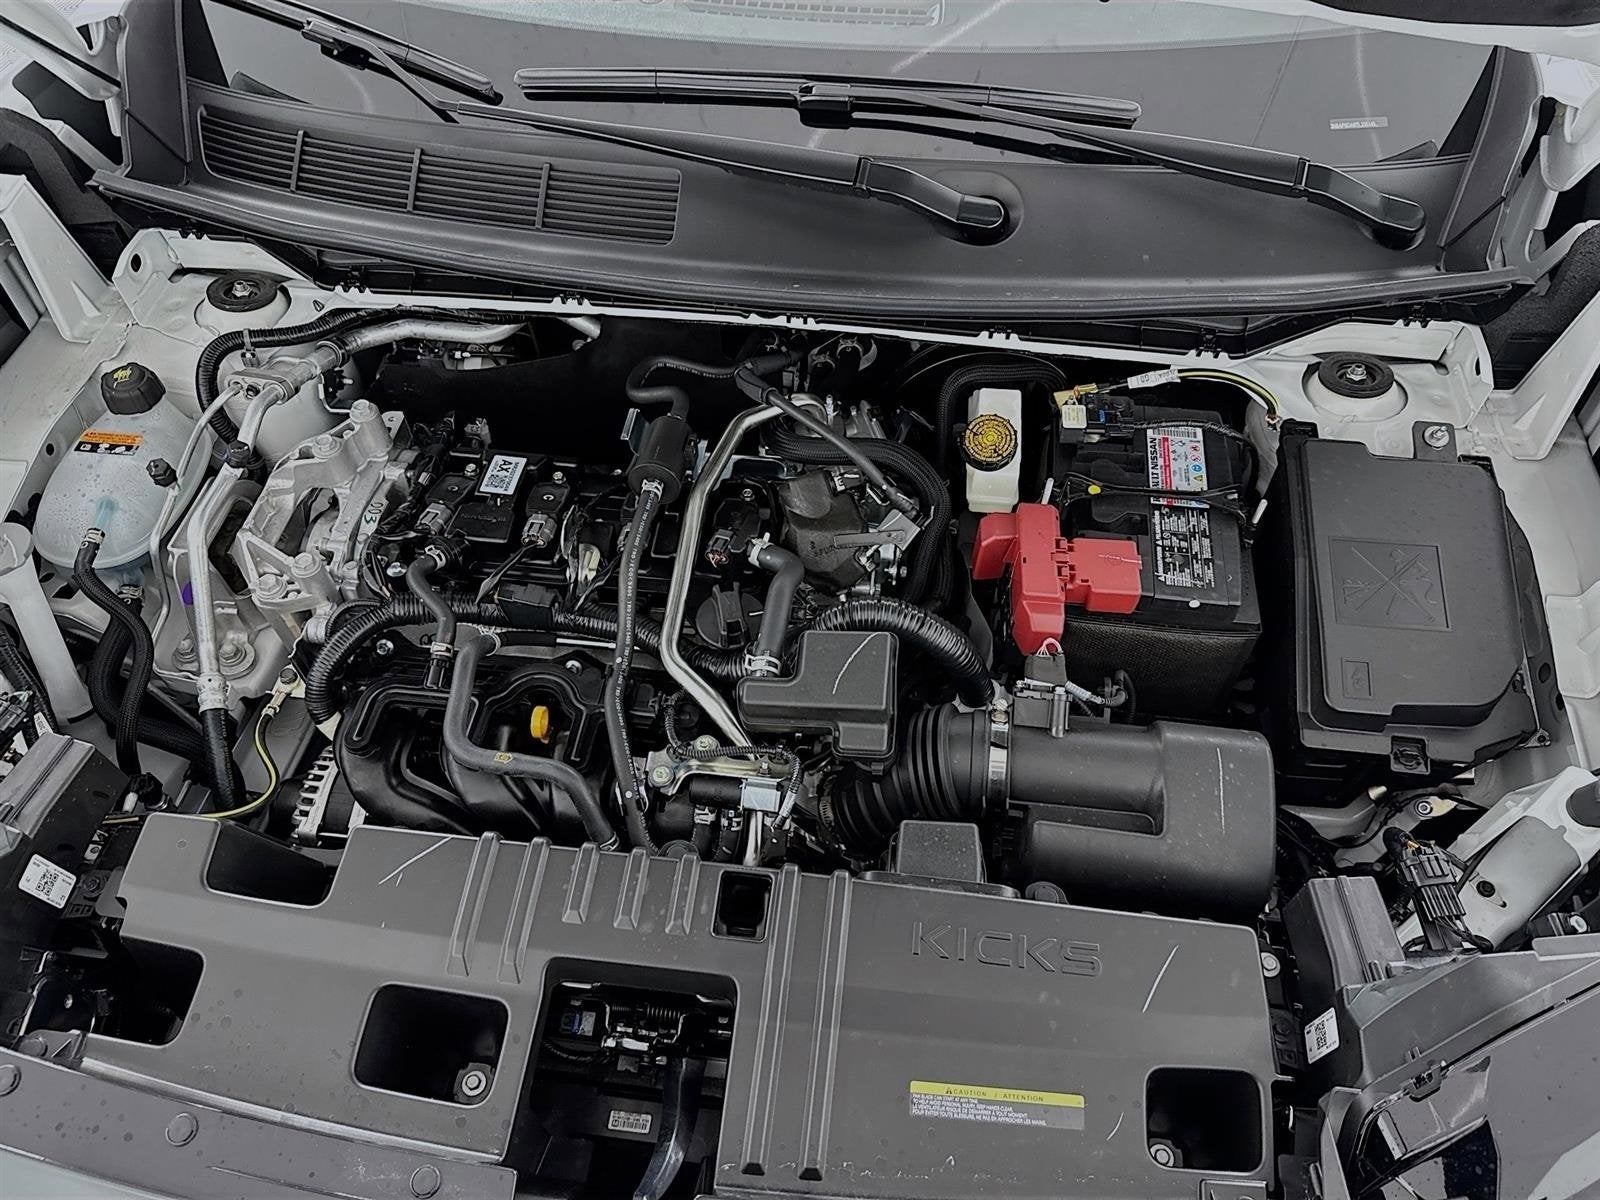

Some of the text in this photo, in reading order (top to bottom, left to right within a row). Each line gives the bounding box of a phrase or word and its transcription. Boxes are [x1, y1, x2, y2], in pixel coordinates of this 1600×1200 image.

[1149, 437, 1158, 469] NISSAN
[497, 459, 513, 473] AX
[911, 921, 1103, 977] KICKS
[953, 1088, 987, 1099] CAUTION
[1002, 1093, 1044, 1103] ATTENTION
